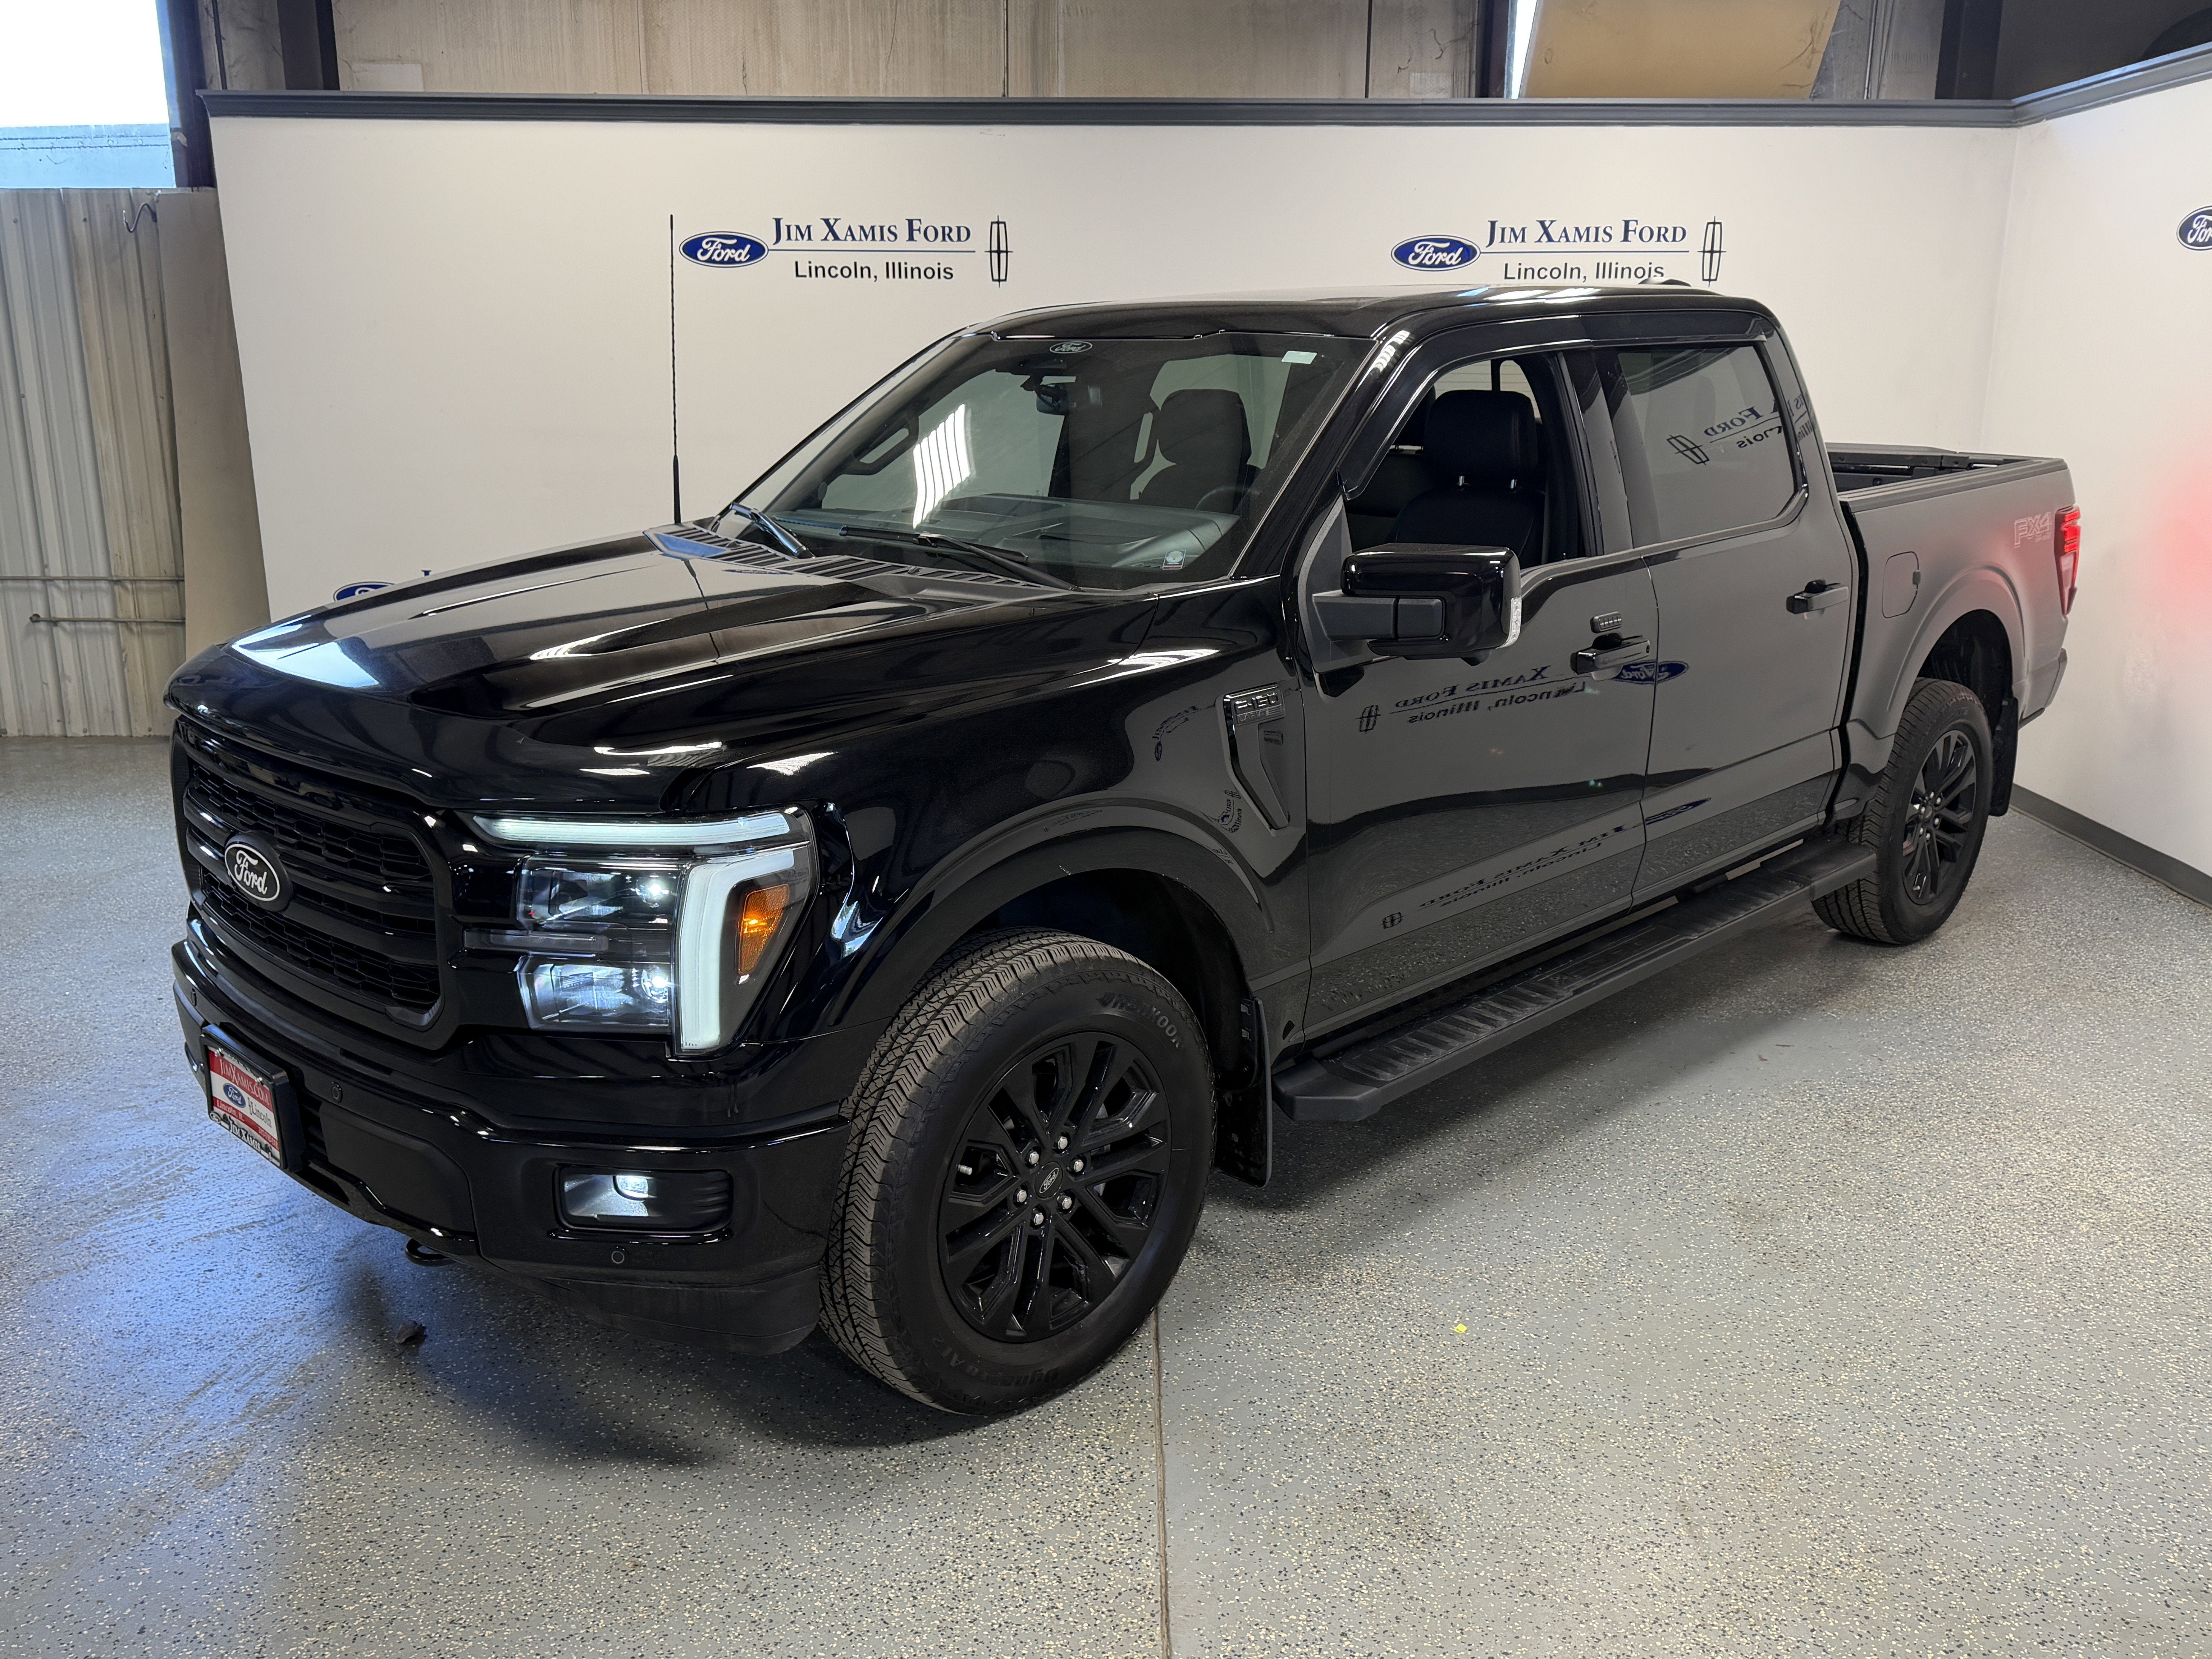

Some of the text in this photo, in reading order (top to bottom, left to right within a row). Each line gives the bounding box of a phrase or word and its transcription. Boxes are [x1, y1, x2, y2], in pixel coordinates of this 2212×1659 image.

[772, 217, 971, 246] JIM XAMIS FORD
[1486, 220, 1687, 248] JIM XAMIS FORD
[2187, 215, 2212, 243] For
[696, 237, 750, 263] Ford
[1408, 240, 1462, 266] Ford
[794, 261, 954, 282] Lincoln, Illinois
[1504, 262, 1664, 283] Lincoln, Illinois
[2014, 512, 2052, 548] FX4
[234, 850, 268, 895] Ford
[227, 1086, 242, 1104] Ford
